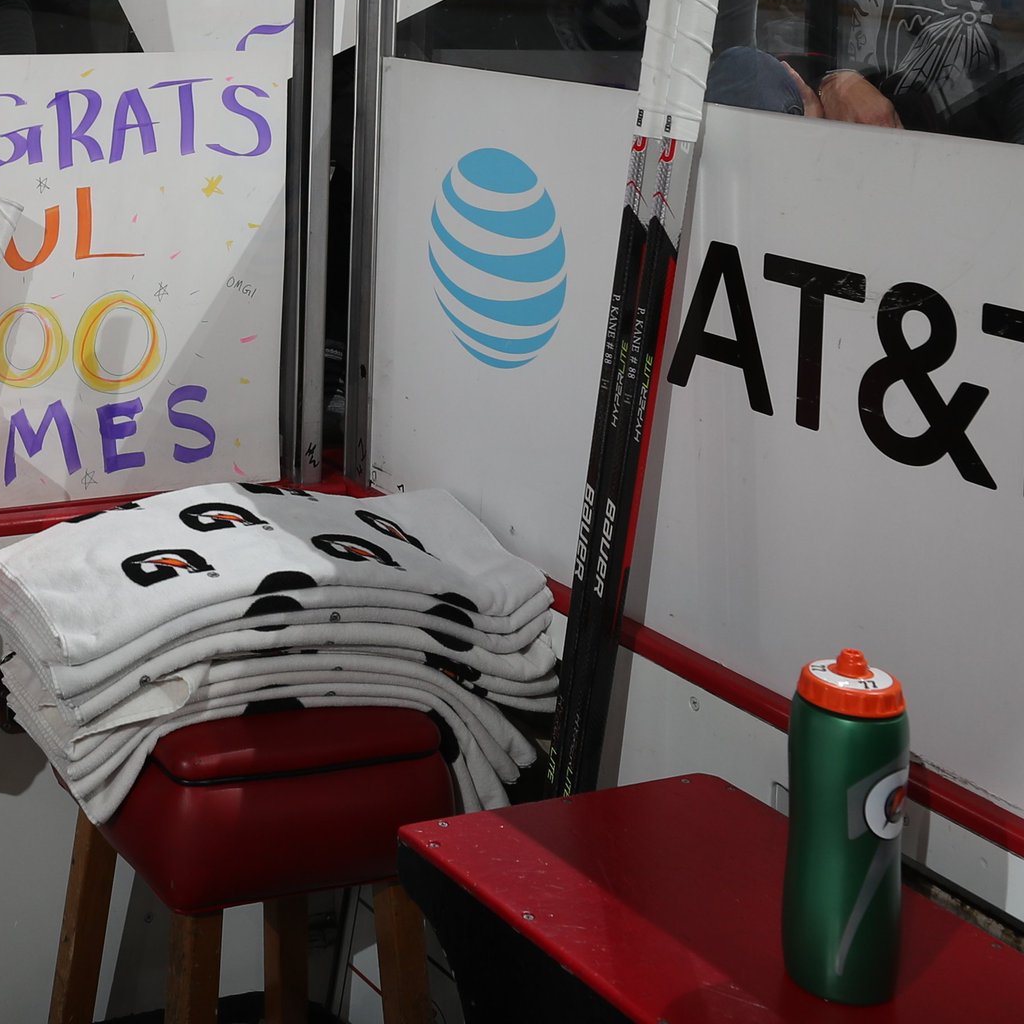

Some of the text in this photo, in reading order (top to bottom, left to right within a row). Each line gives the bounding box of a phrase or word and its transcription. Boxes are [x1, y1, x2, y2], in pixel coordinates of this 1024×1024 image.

[226, 276, 258, 299] OMG!
[608, 305, 619, 338] KANE
[632, 319, 644, 353] KANE
[604, 352, 613, 365] 88
[627, 366, 636, 379] 88
[611, 339, 629, 427] HYPERLITE
[634, 353, 654, 443] HYPERLITE
